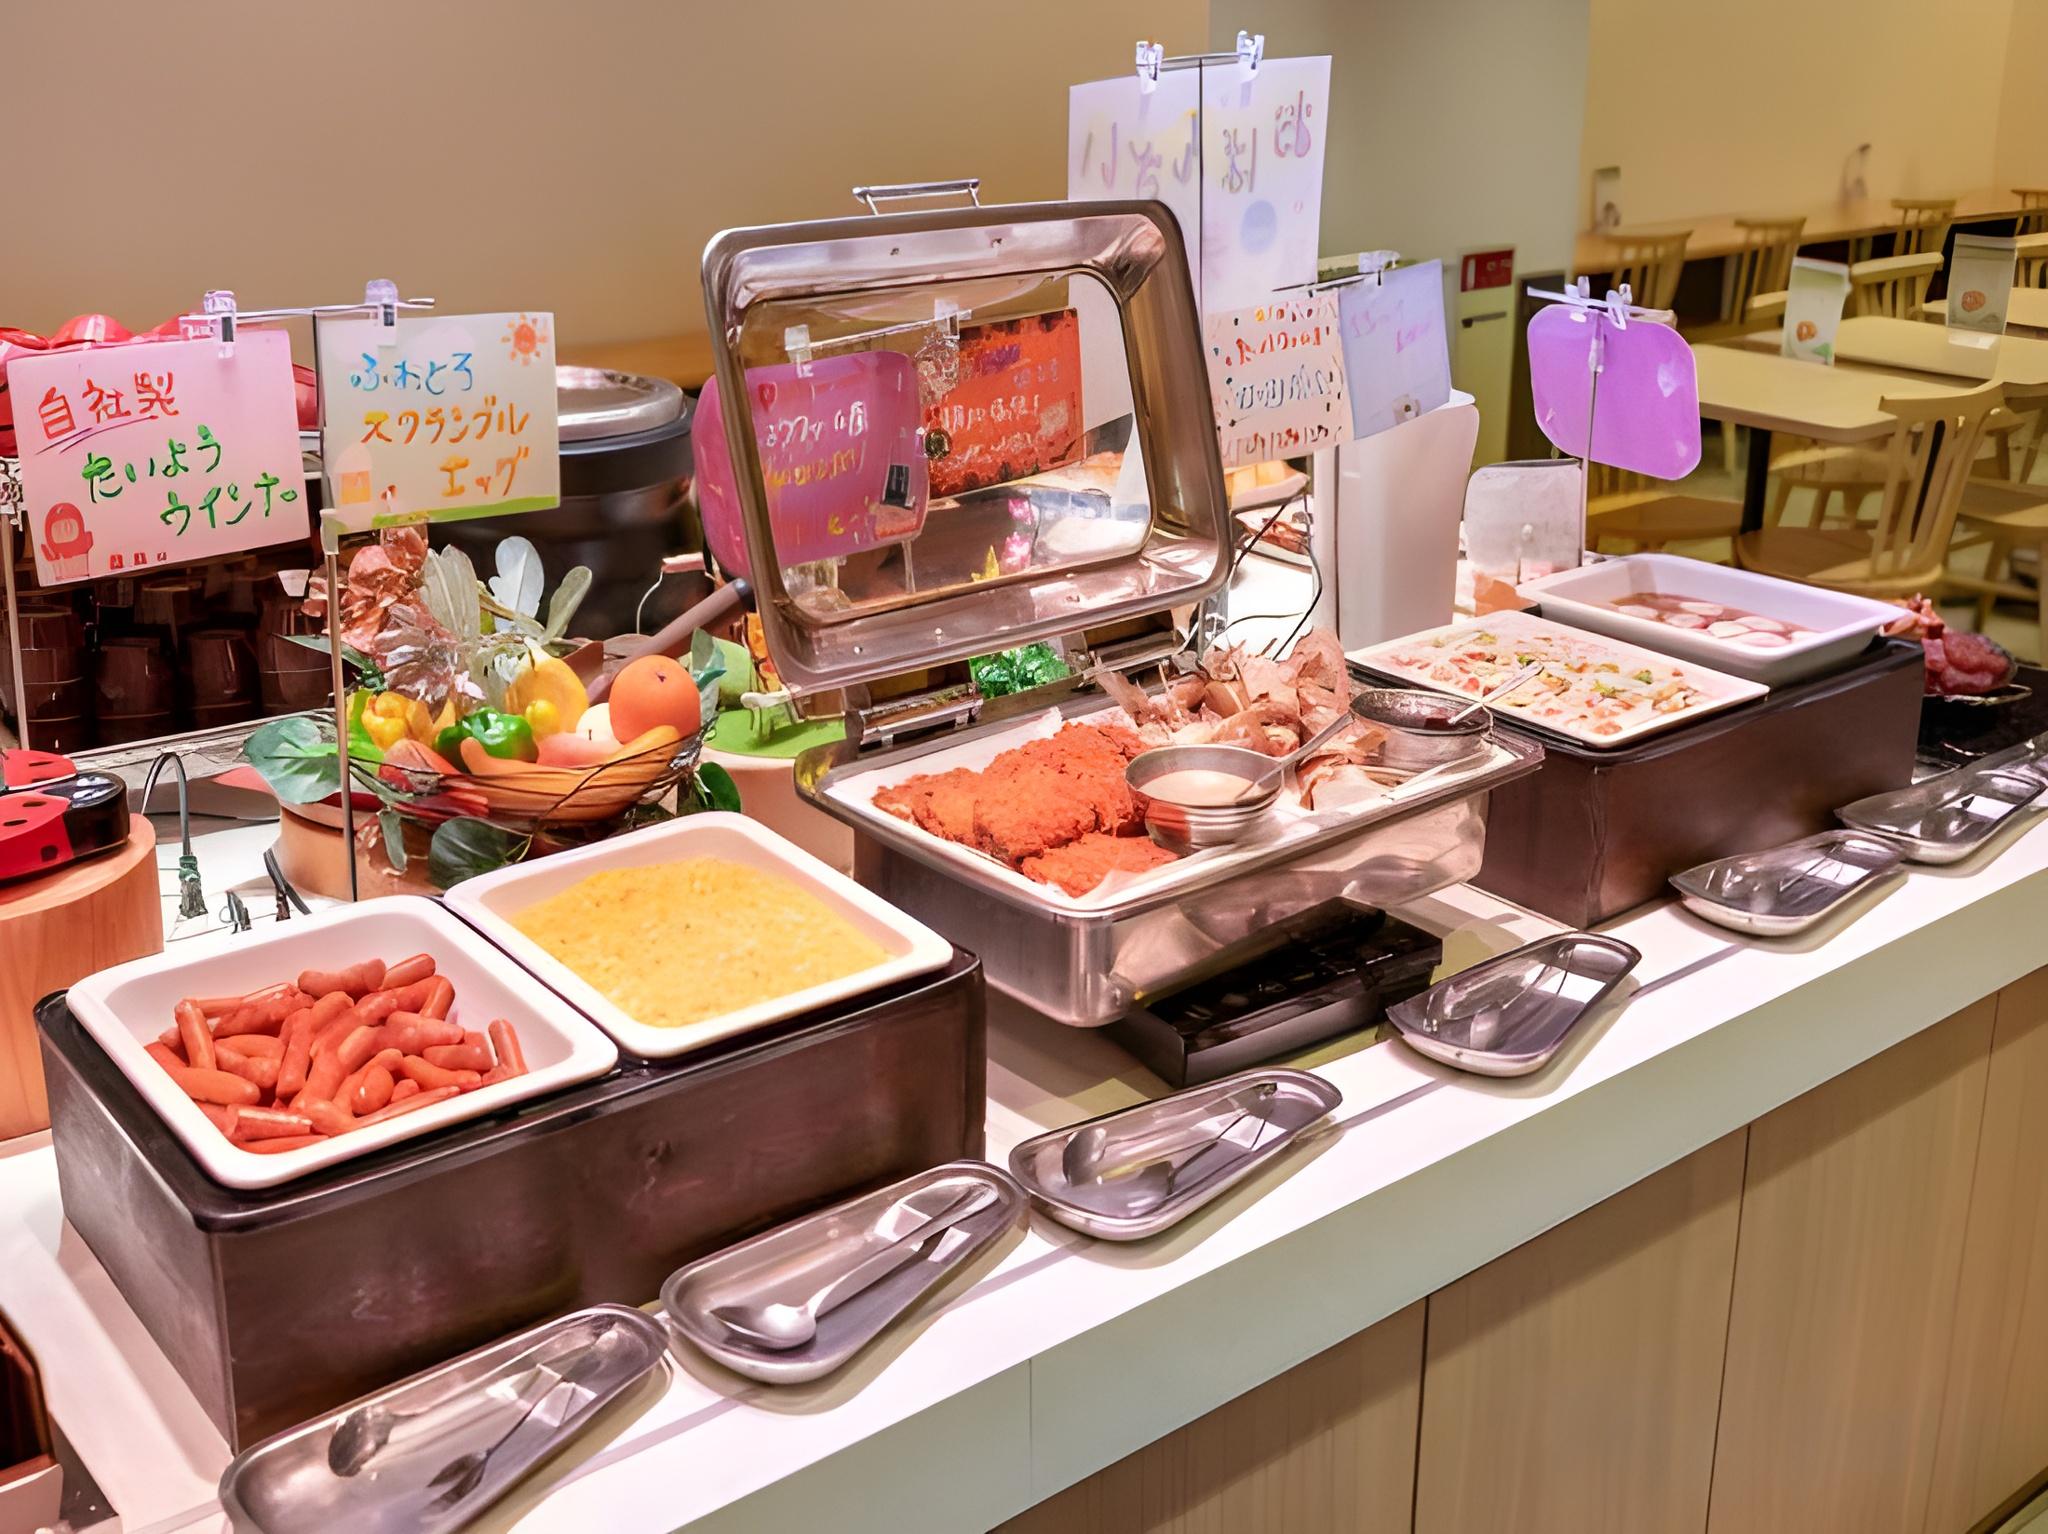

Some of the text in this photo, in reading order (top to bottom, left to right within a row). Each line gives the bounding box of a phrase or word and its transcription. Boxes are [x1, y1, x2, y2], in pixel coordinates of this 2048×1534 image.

[38, 372, 180, 439] 自社製
[360, 395, 530, 444] スクランブル
[439, 446, 530, 497] エッグ
